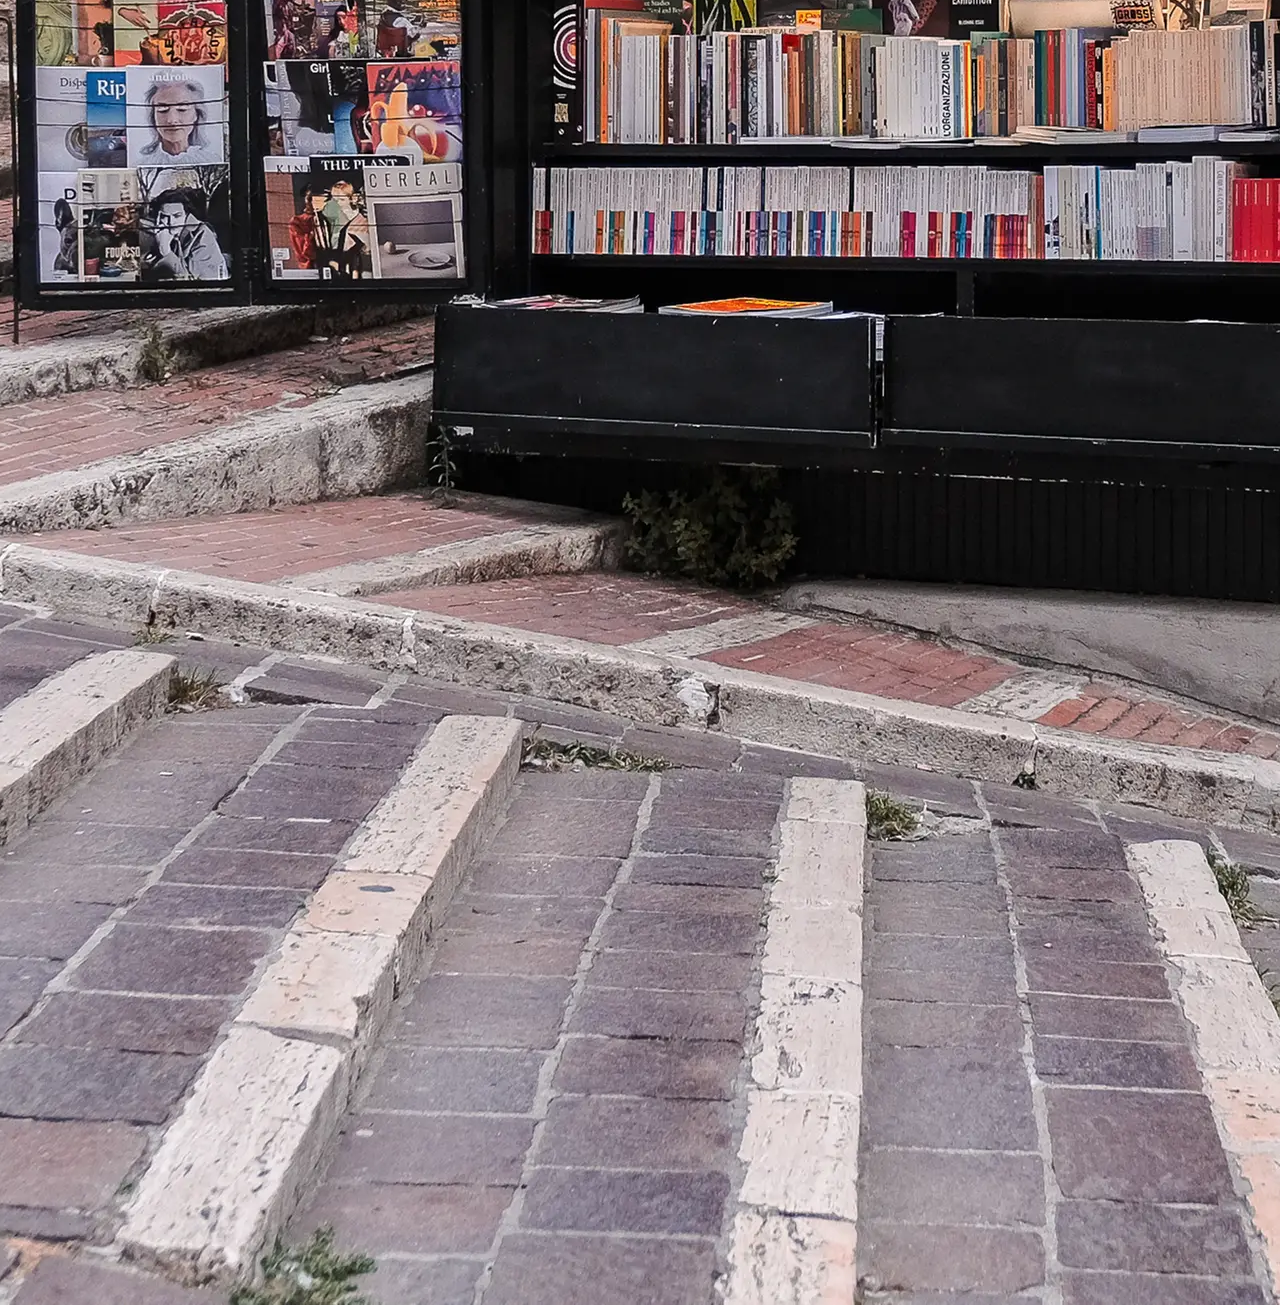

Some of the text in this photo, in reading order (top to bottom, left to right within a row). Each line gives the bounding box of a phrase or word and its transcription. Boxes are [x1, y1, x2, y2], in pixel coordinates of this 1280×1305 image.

[1116, 8, 1151, 21] GROSS
[941, 51, 951, 138] L'ORGANIZZAZIONE
[320, 159, 351, 171] THE
[369, 169, 453, 189] CEREAL
